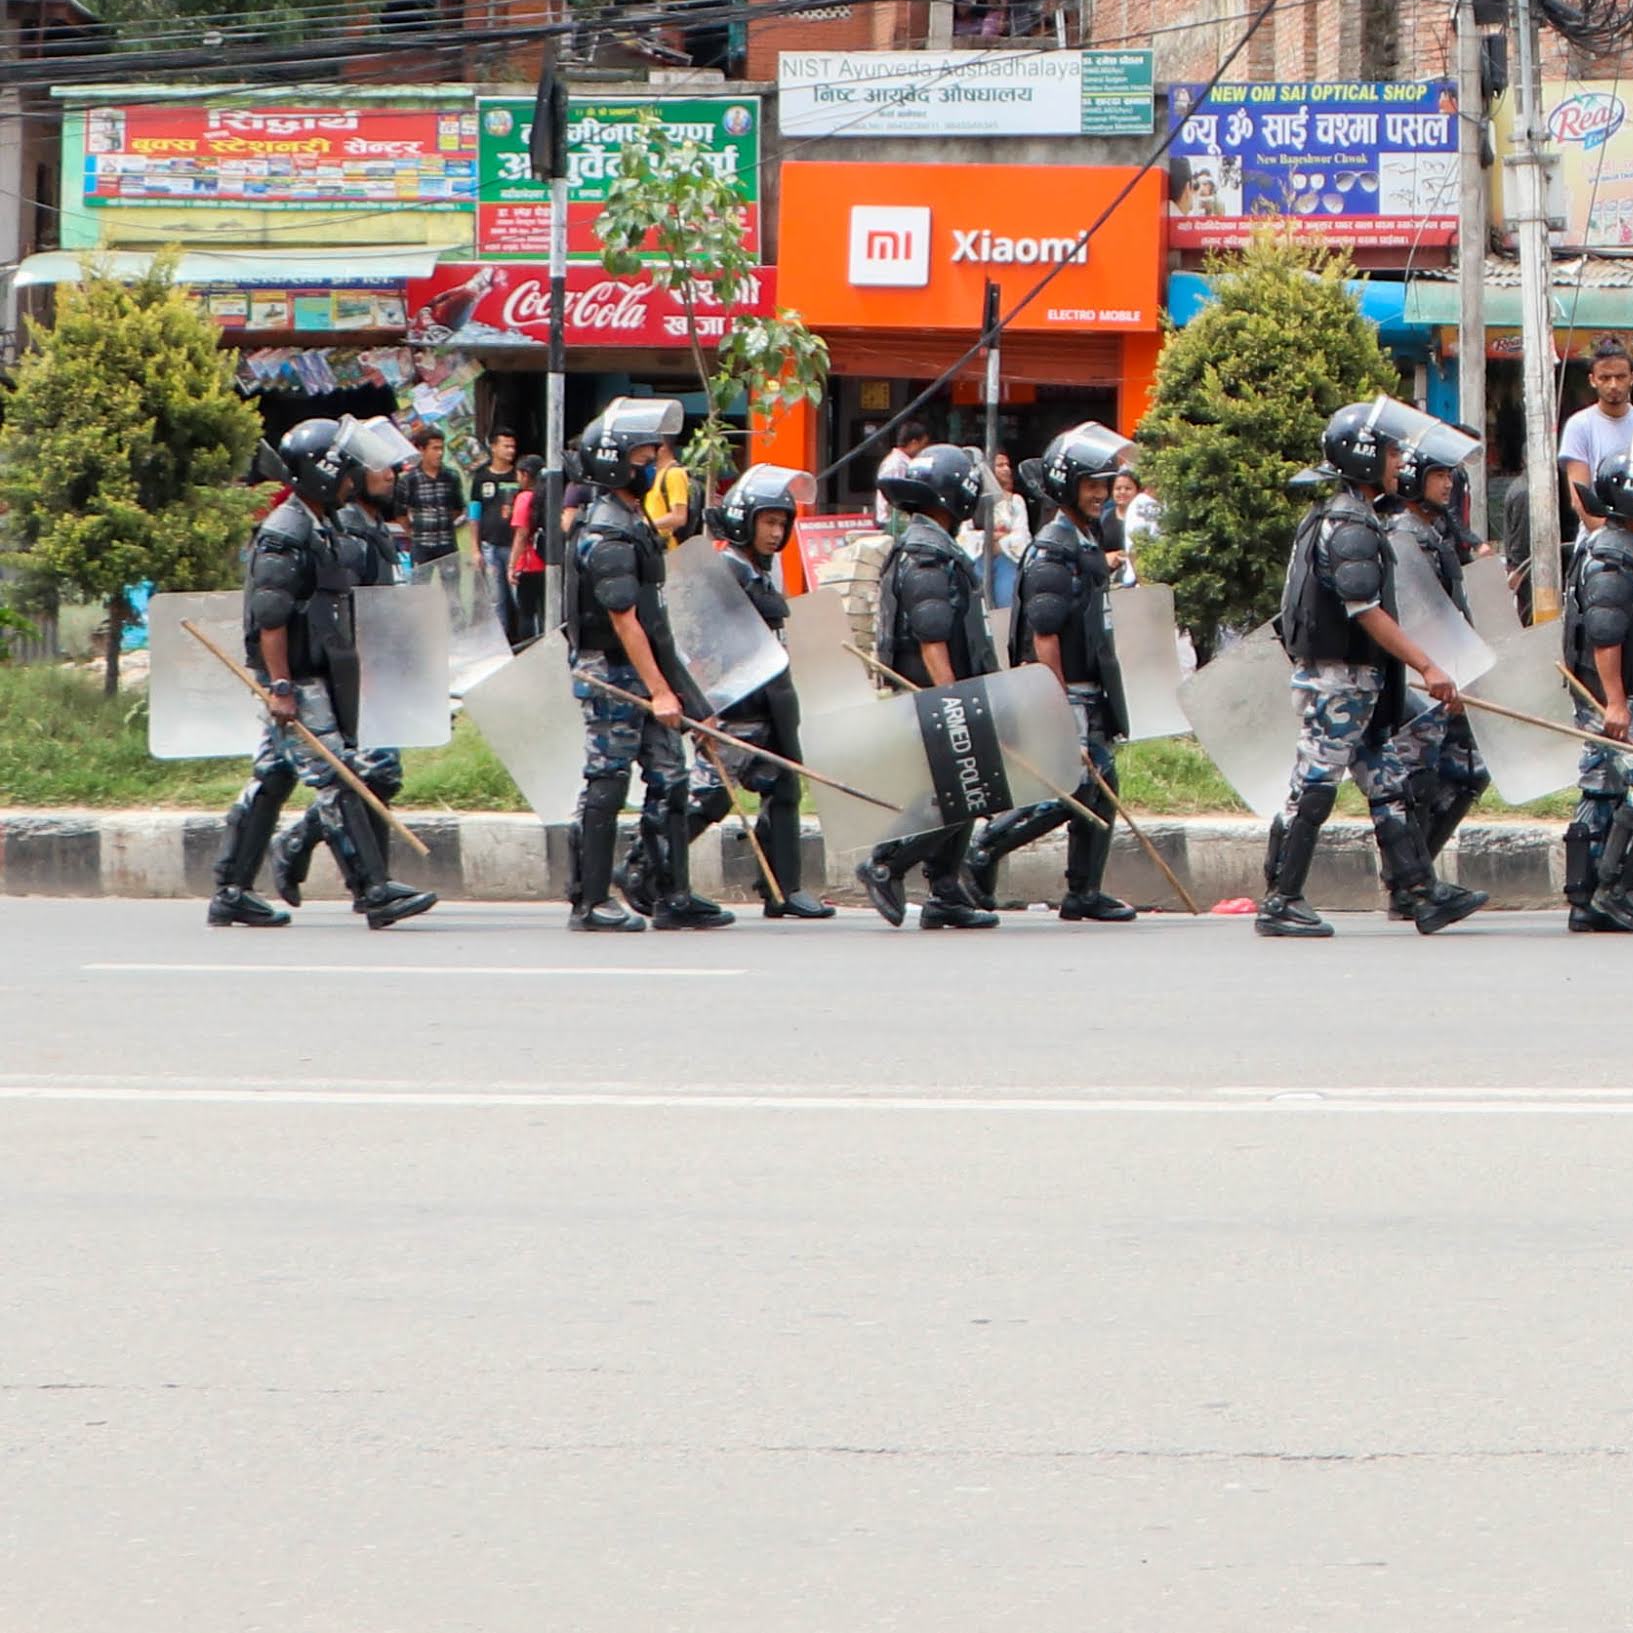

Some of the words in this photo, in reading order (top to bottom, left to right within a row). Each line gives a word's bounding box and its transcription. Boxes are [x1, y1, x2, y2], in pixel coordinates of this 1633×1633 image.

[781, 58, 832, 78] NIST
[839, 58, 937, 82] Ayurveda
[1210, 85, 1247, 102] NEW
[1251, 85, 1277, 102] OM
[1280, 85, 1307, 102] SAI
[1311, 84, 1379, 102] OPTICAL
[1383, 84, 1428, 101] SHOP
[1262, 105, 1308, 150] साई
[1385, 113, 1450, 147] पसल
[208, 136, 331, 155] स्टेशनरी
[1257, 153, 1278, 164] New
[952, 229, 1088, 264] Xiaomi
[1047, 308, 1095, 321] ELECTRO
[1099, 309, 1142, 322] MOBILE
[941, 696, 972, 754] ARMED
[956, 756, 988, 812] POLICE
